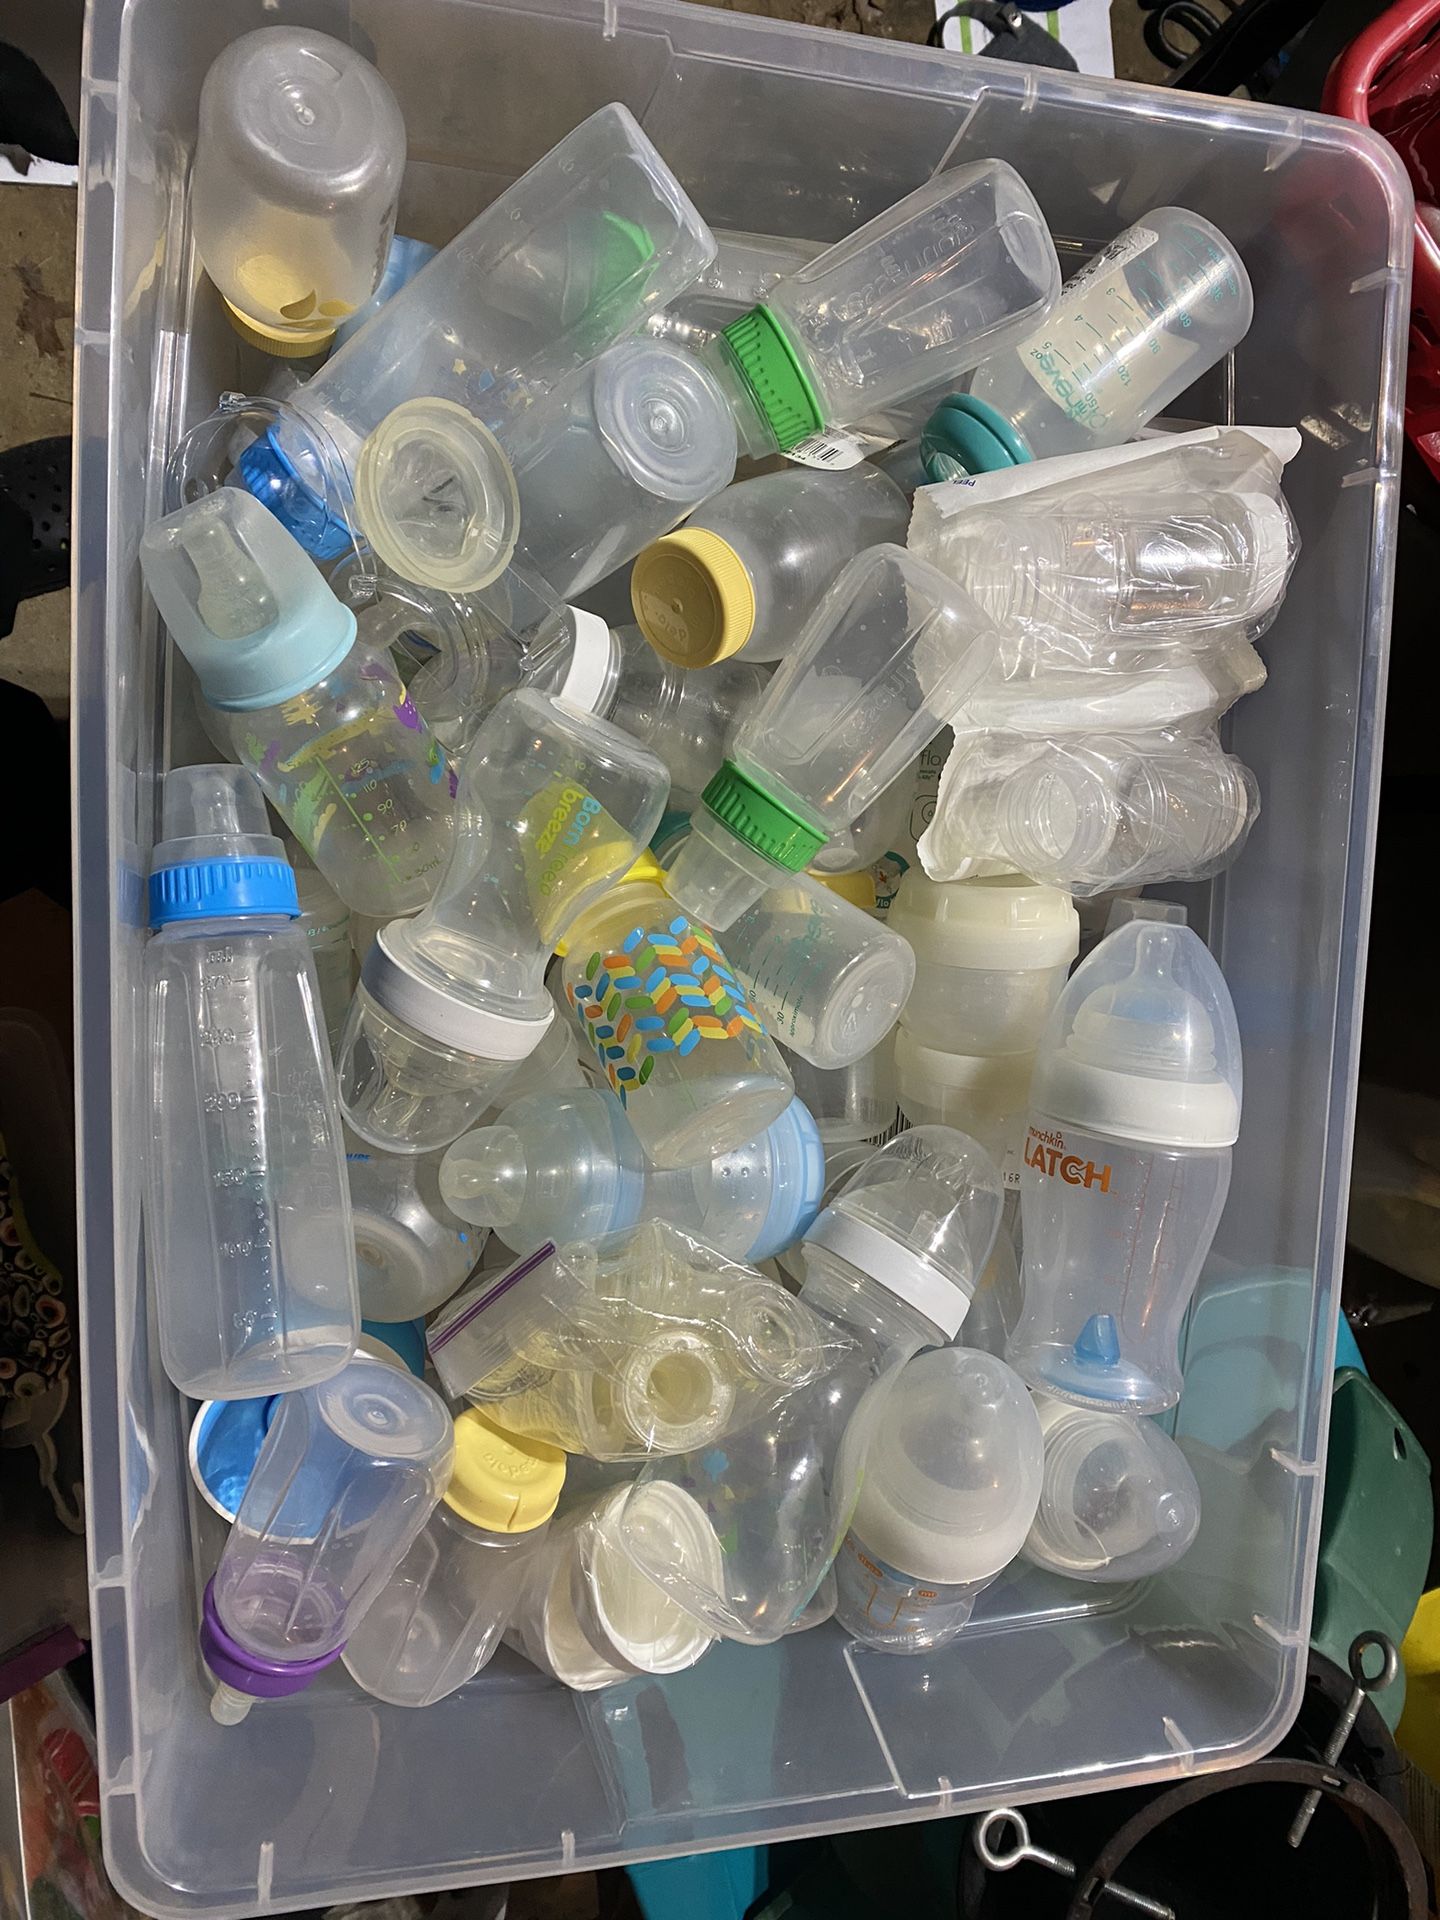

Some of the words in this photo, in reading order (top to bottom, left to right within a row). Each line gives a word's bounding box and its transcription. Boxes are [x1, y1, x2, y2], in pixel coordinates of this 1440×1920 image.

[1179, 311, 1192, 328] 60
[1149, 339, 1161, 354] 90
[1117, 365, 1132, 387] 120
[1085, 393, 1099, 411] 150
[363, 780, 377, 793] 110
[377, 798, 393, 815] 90
[391, 820, 407, 836] 70
[535, 788, 585, 854] breeze
[563, 796, 602, 846] Born
[776, 1011, 785, 1025] 30
[1024, 1136, 1112, 1193] LATCH
